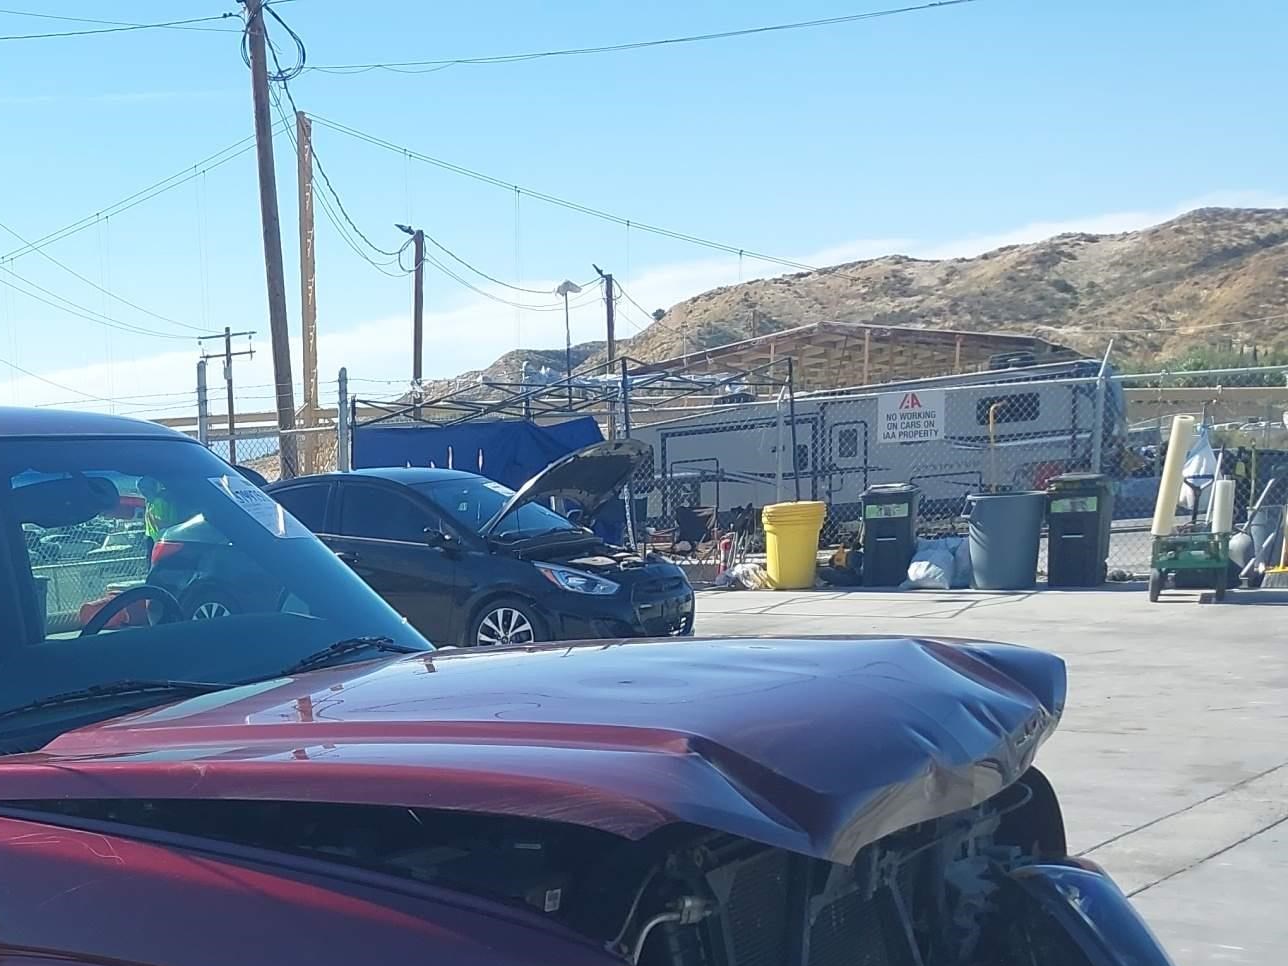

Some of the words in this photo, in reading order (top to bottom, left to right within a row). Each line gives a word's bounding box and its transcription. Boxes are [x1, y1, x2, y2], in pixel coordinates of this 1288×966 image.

[886, 412, 897, 421] NO
[900, 410, 936, 420] WORKING
[887, 422, 898, 430] ON
[901, 420, 921, 429] CARS
[924, 419, 935, 428] ON
[883, 431, 896, 440] IAA
[899, 429, 938, 439] PROPERTY
